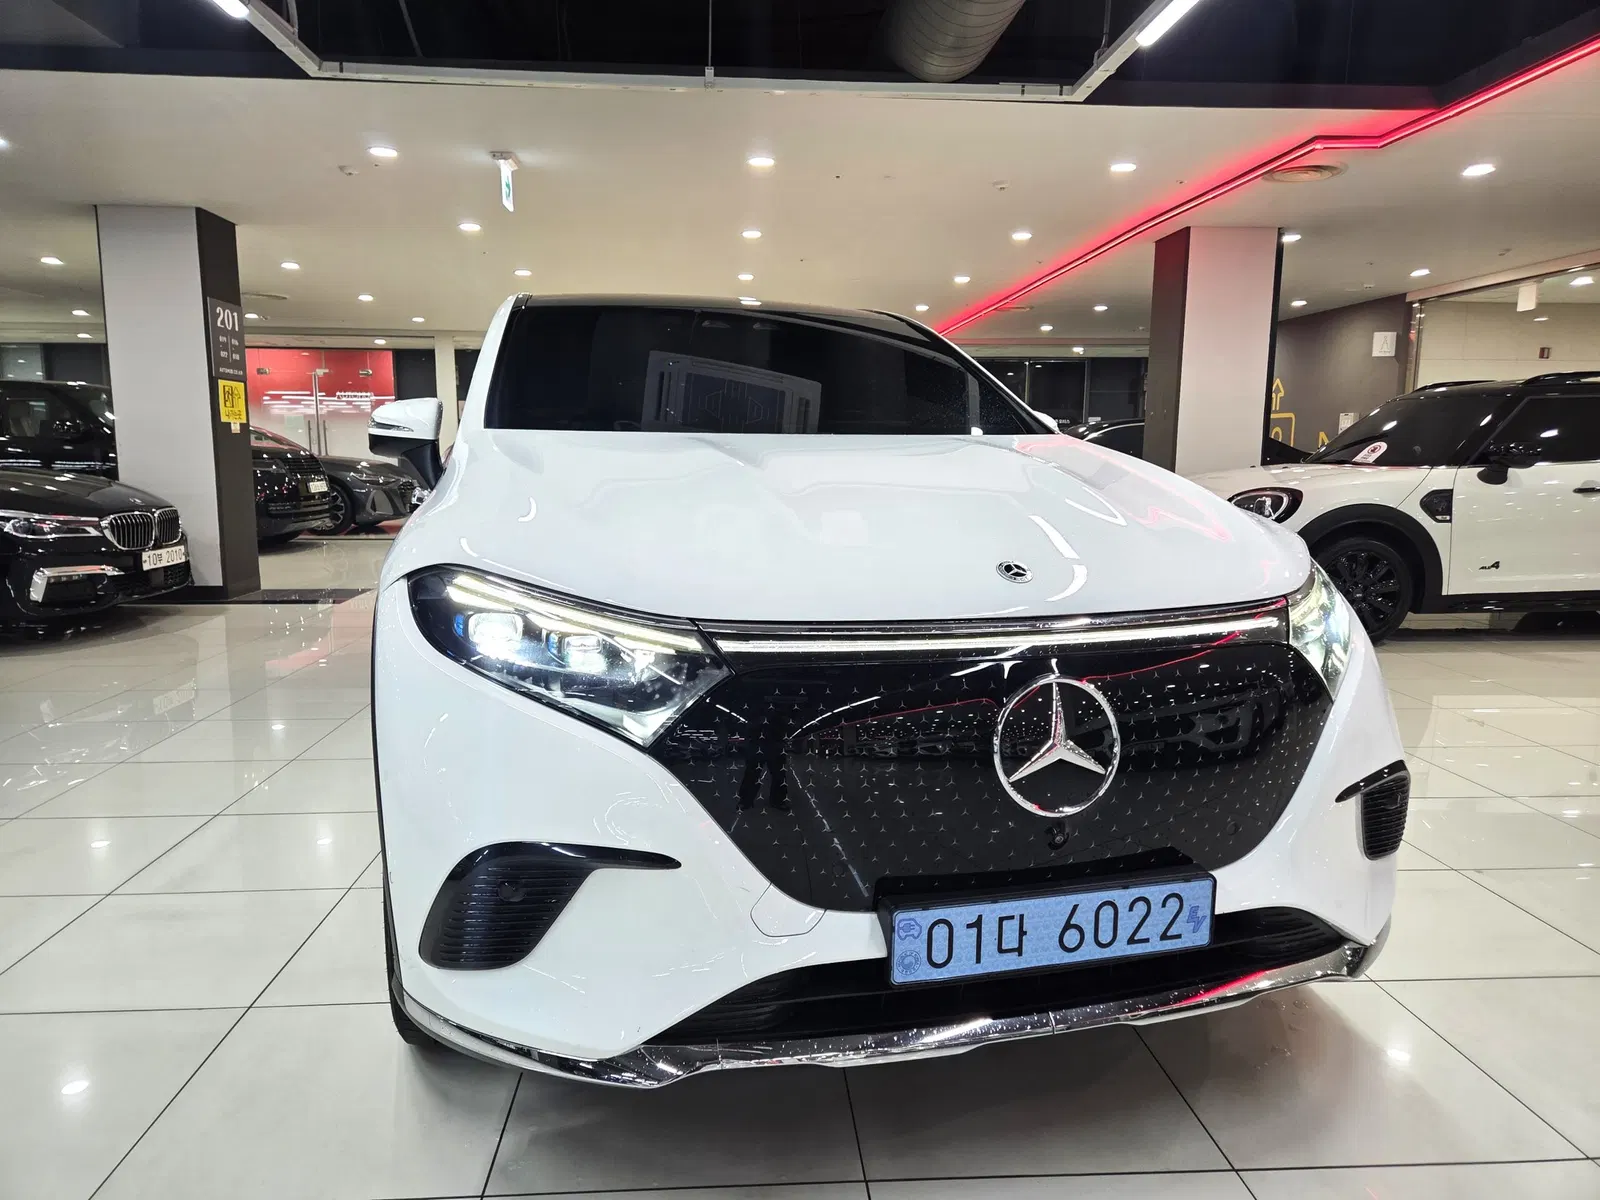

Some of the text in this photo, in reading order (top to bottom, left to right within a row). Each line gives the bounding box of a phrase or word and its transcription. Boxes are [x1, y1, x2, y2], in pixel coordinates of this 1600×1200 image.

[216, 306, 239, 332] 201
[165, 548, 183, 563] 2010
[926, 913, 1027, 969] 01다
[1058, 892, 1184, 953] 6022
